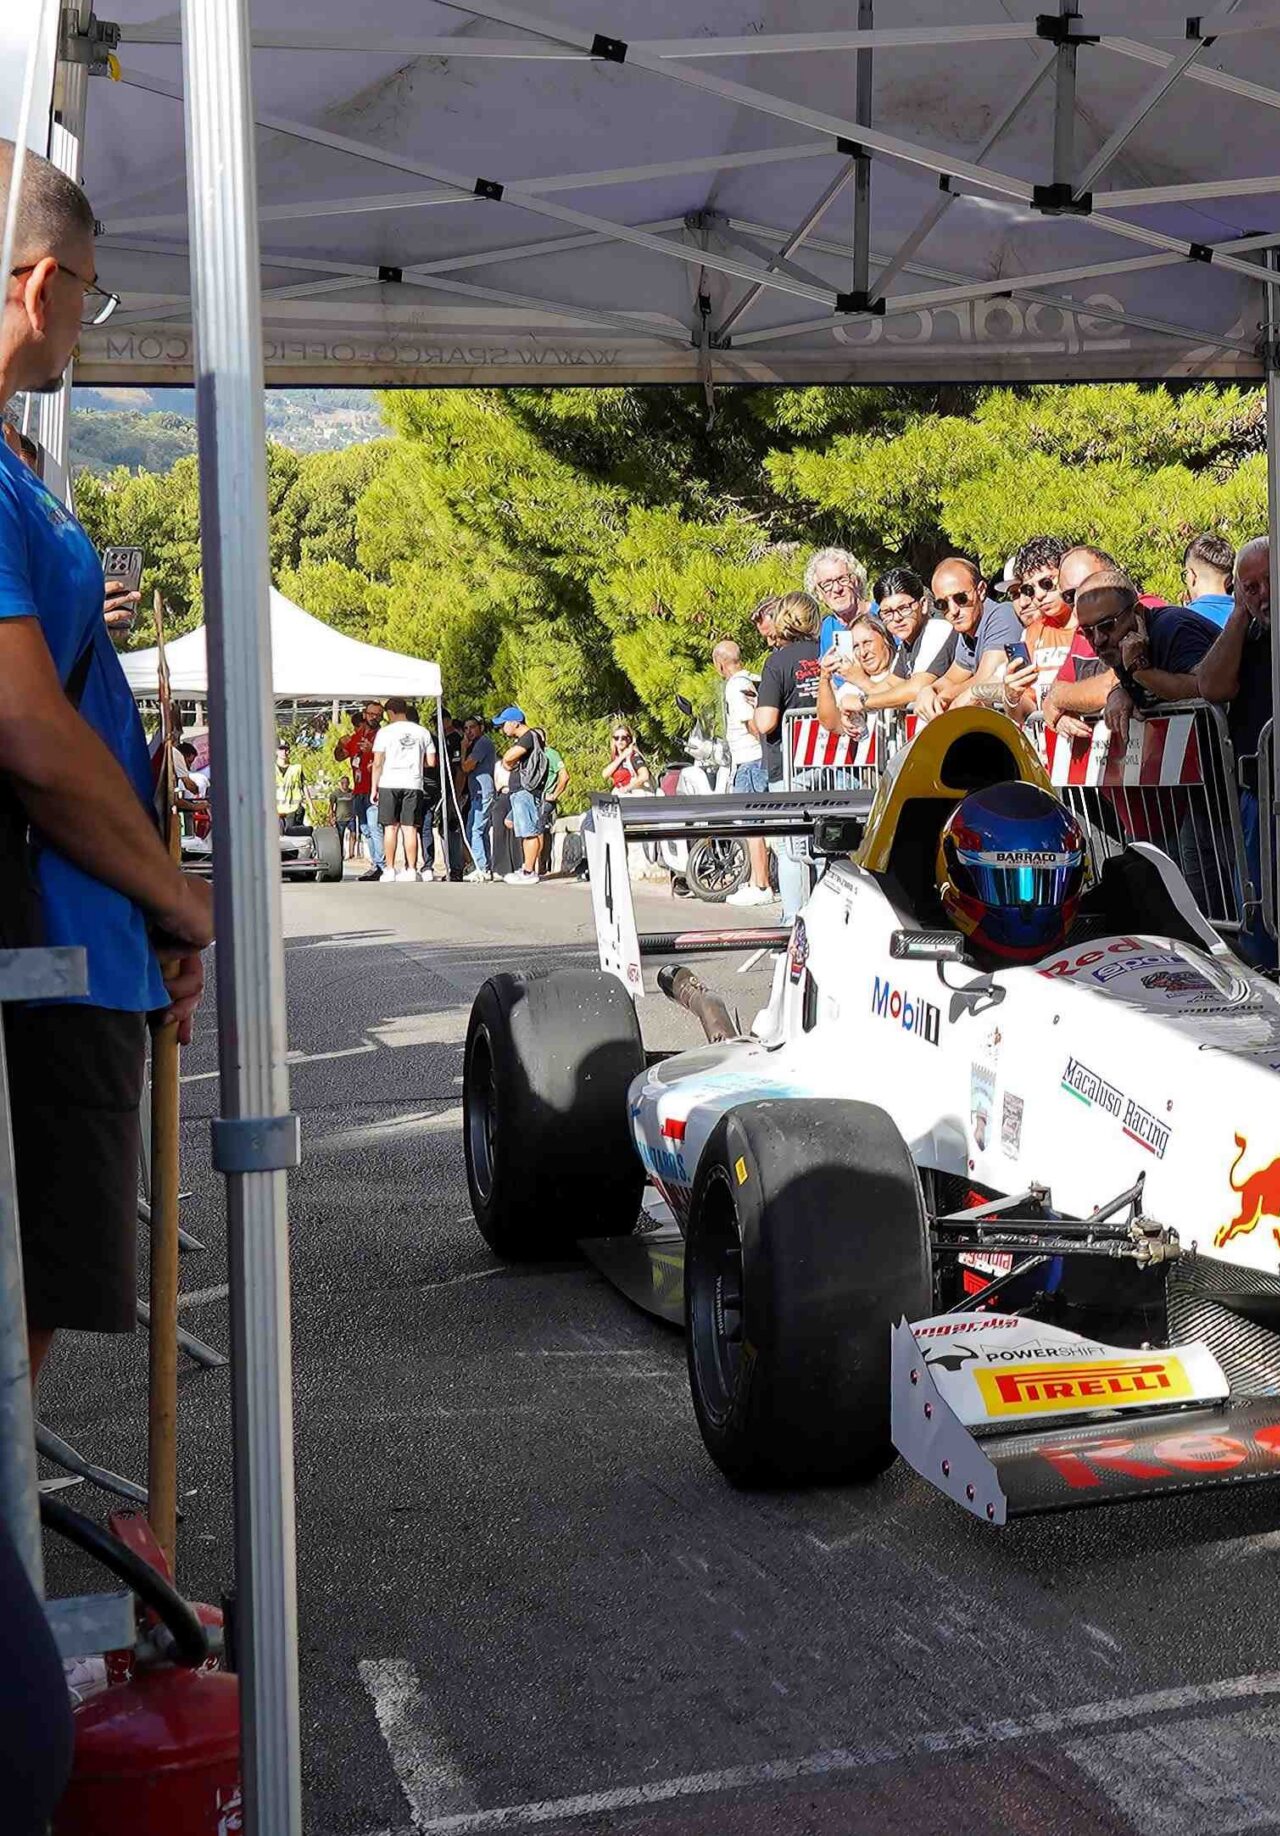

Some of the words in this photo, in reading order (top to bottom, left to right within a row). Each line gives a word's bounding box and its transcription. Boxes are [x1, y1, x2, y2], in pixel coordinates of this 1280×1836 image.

[996, 852, 1057, 862] BARRACO
[1036, 936, 1146, 979] Red
[1091, 954, 1187, 984] spar
[1061, 1055, 1125, 1118] Macaluso
[1122, 1098, 1172, 1161] Racing
[986, 1345, 1107, 1363] POWERSHIFT
[995, 1364, 1171, 1404] PIRELLI
